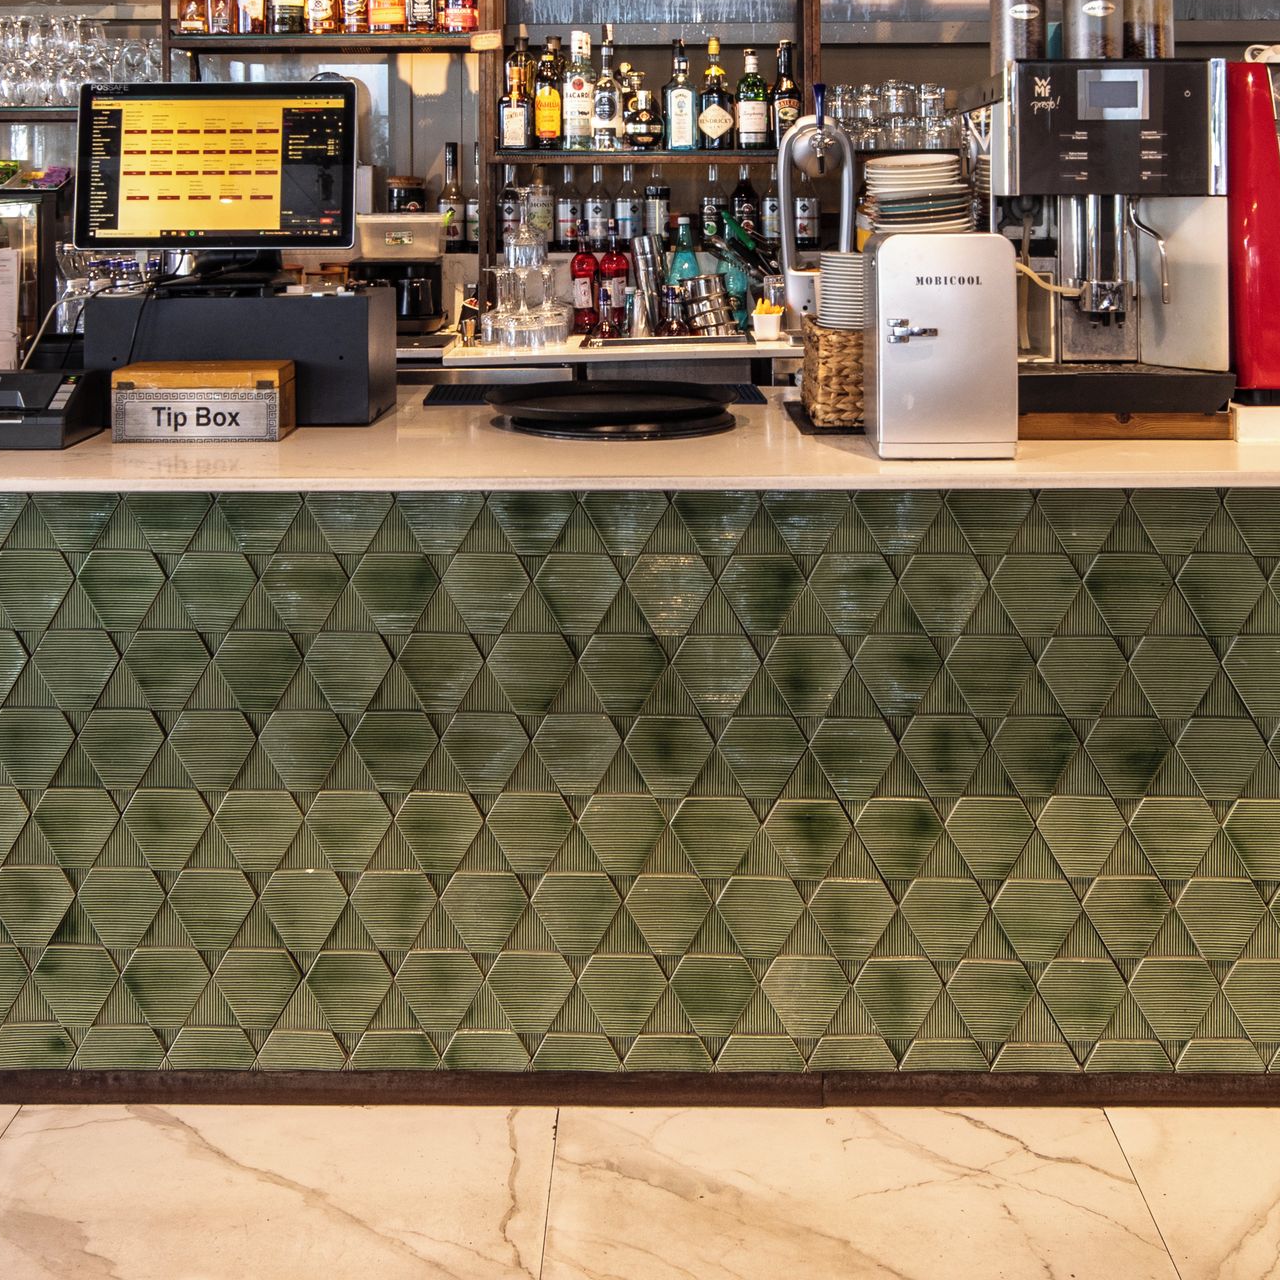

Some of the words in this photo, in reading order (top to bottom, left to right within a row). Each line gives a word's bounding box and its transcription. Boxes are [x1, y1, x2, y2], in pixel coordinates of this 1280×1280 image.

[91, 83, 130, 91] POSSAFE
[915, 276, 983, 286] MOBICOOL
[151, 406, 187, 433] Tip
[195, 406, 240, 427] Box
